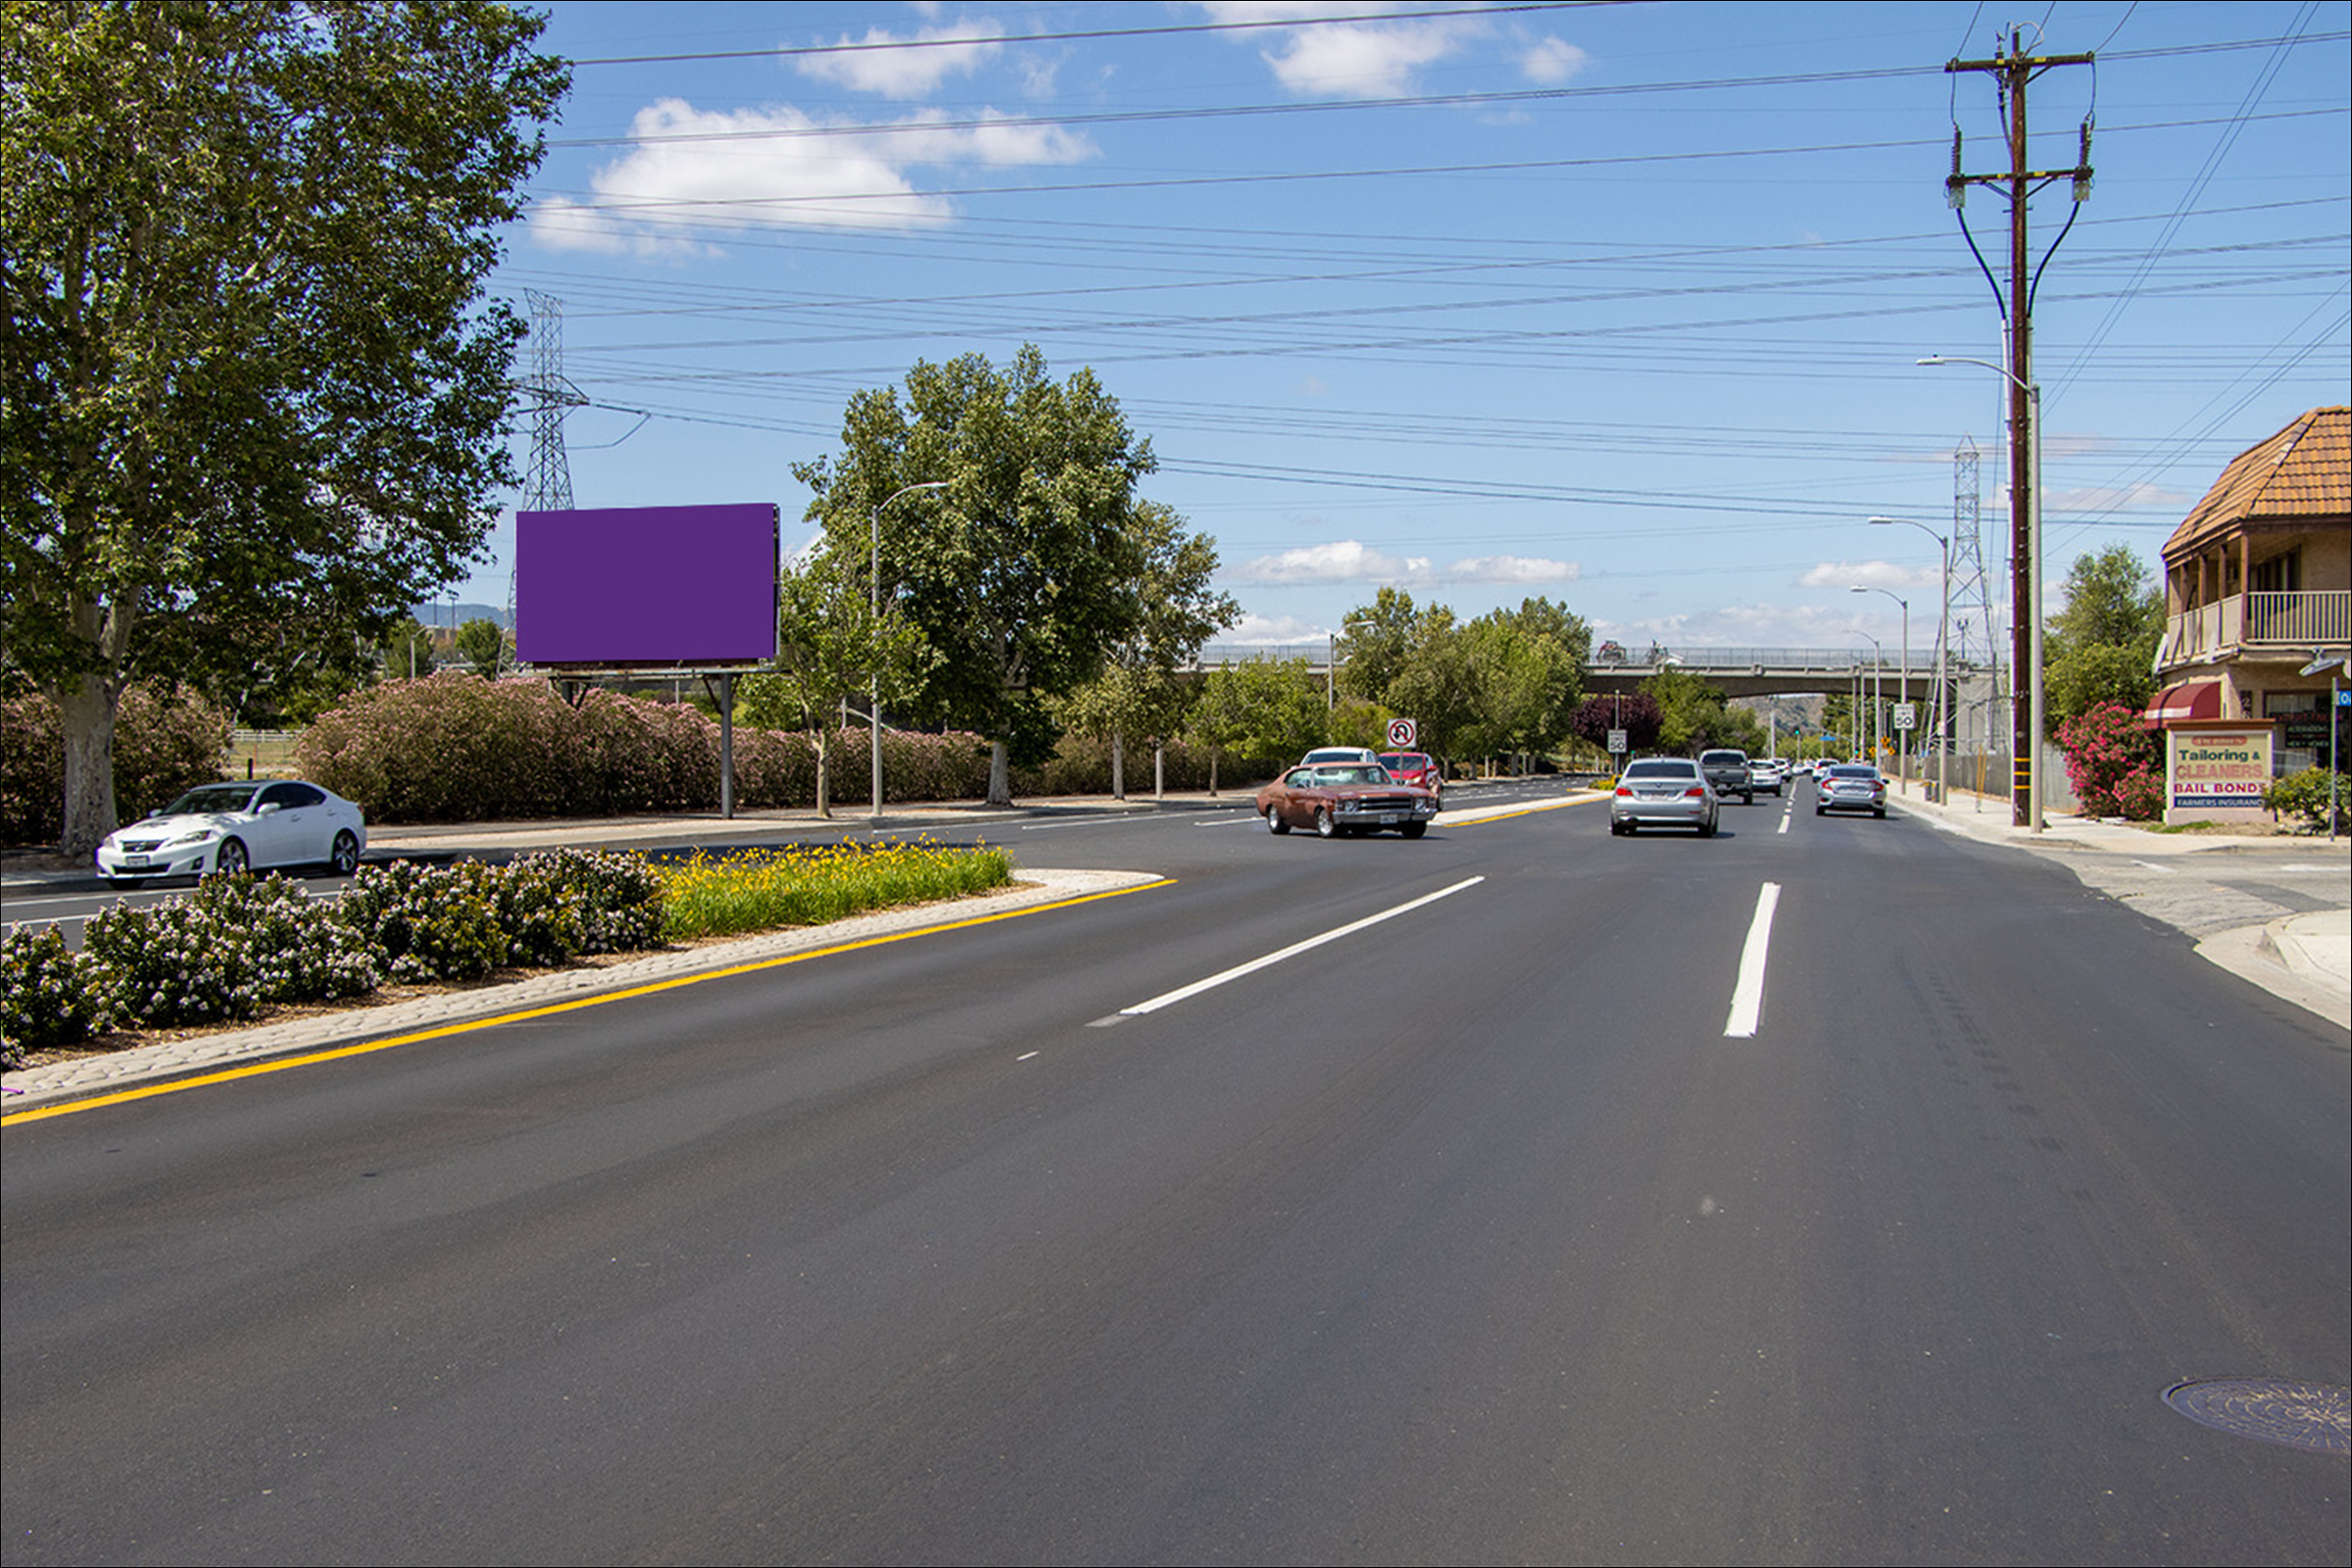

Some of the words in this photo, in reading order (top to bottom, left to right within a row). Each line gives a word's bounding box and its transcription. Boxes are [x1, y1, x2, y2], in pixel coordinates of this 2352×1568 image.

[1895, 716, 1913, 726] 50
[2179, 749, 2248, 762] Tailoring
[2252, 752, 2260, 760] &
[2176, 764, 2263, 779] CLEANERS
[2175, 783, 2209, 793] BAIL
[2177, 799, 2217, 808] FARMERS
